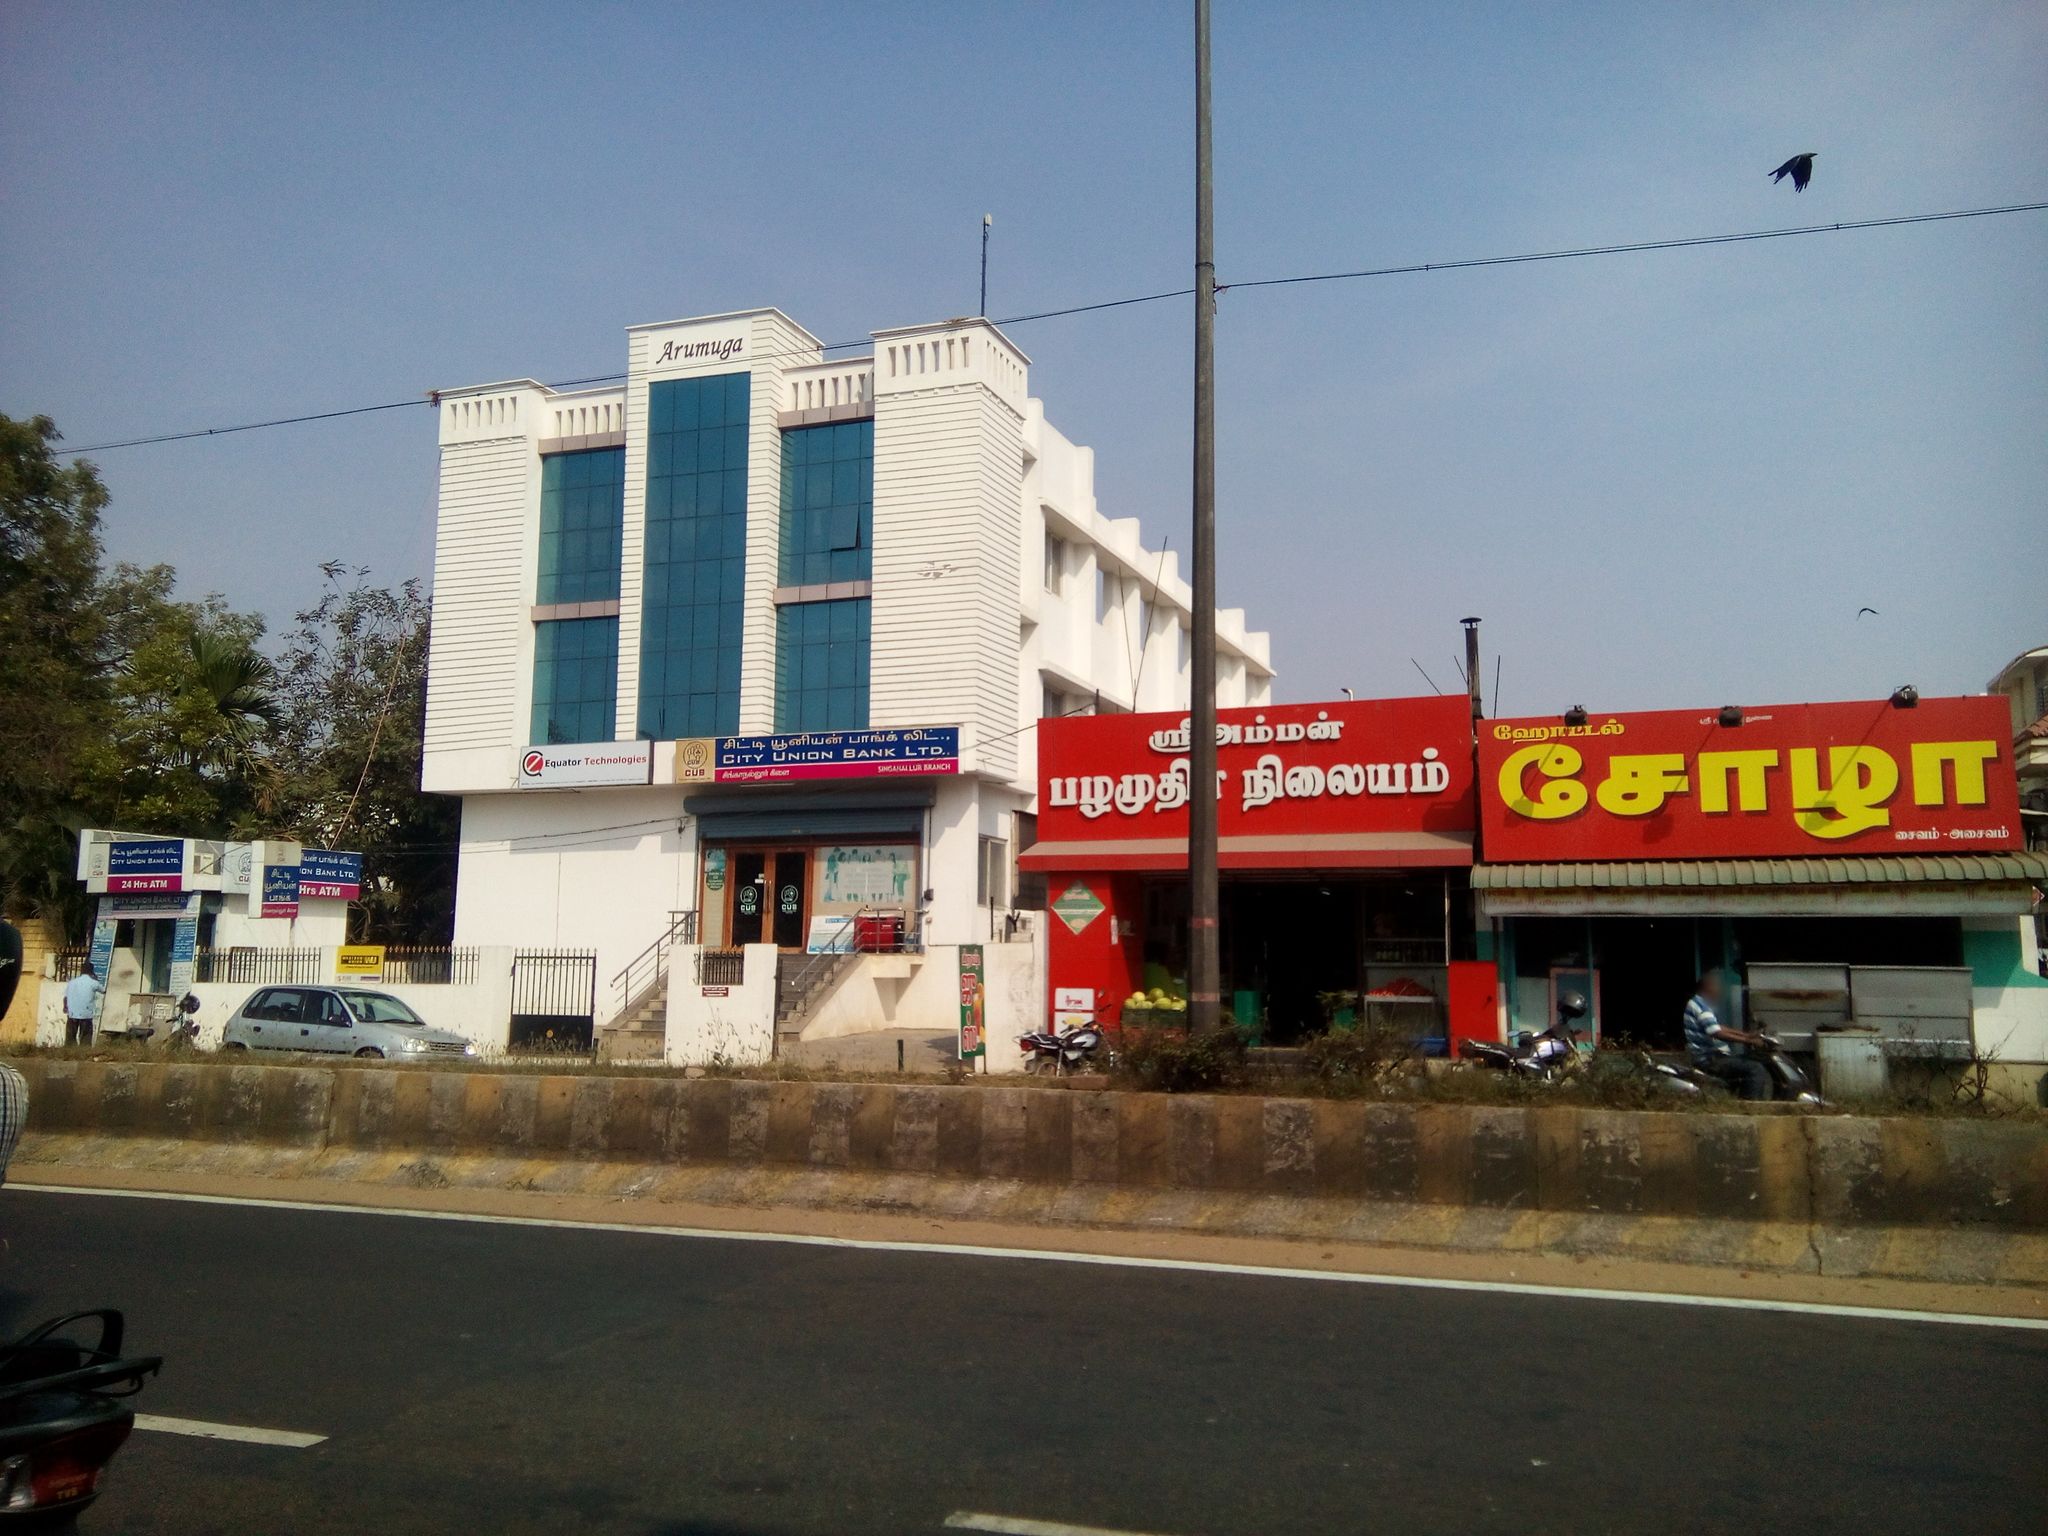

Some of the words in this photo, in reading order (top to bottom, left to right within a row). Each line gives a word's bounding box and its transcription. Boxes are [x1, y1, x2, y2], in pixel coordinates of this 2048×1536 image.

[656, 337, 743, 364] Arumuga
[723, 738, 766, 751] சிட்டி
[771, 733, 844, 750] யூனியன்
[848, 731, 898, 745] பாங்க்
[545, 758, 582, 769] Equator
[585, 754, 647, 767] Technologies
[923, 762, 951, 772] BRANCH
[685, 768, 705, 777] CUB
[1242, 747, 1450, 813] நிலையம்
[1498, 740, 1998, 839] சோழா
[1895, 826, 1940, 841] சைவம்
[1949, 825, 2009, 840] அசைவம்
[121, 880, 132, 889] 24
[133, 880, 148, 889] Hrs
[149, 880, 168, 888] ATM
[318, 885, 341, 897] ATM
[781, 903, 798, 911] CUB
